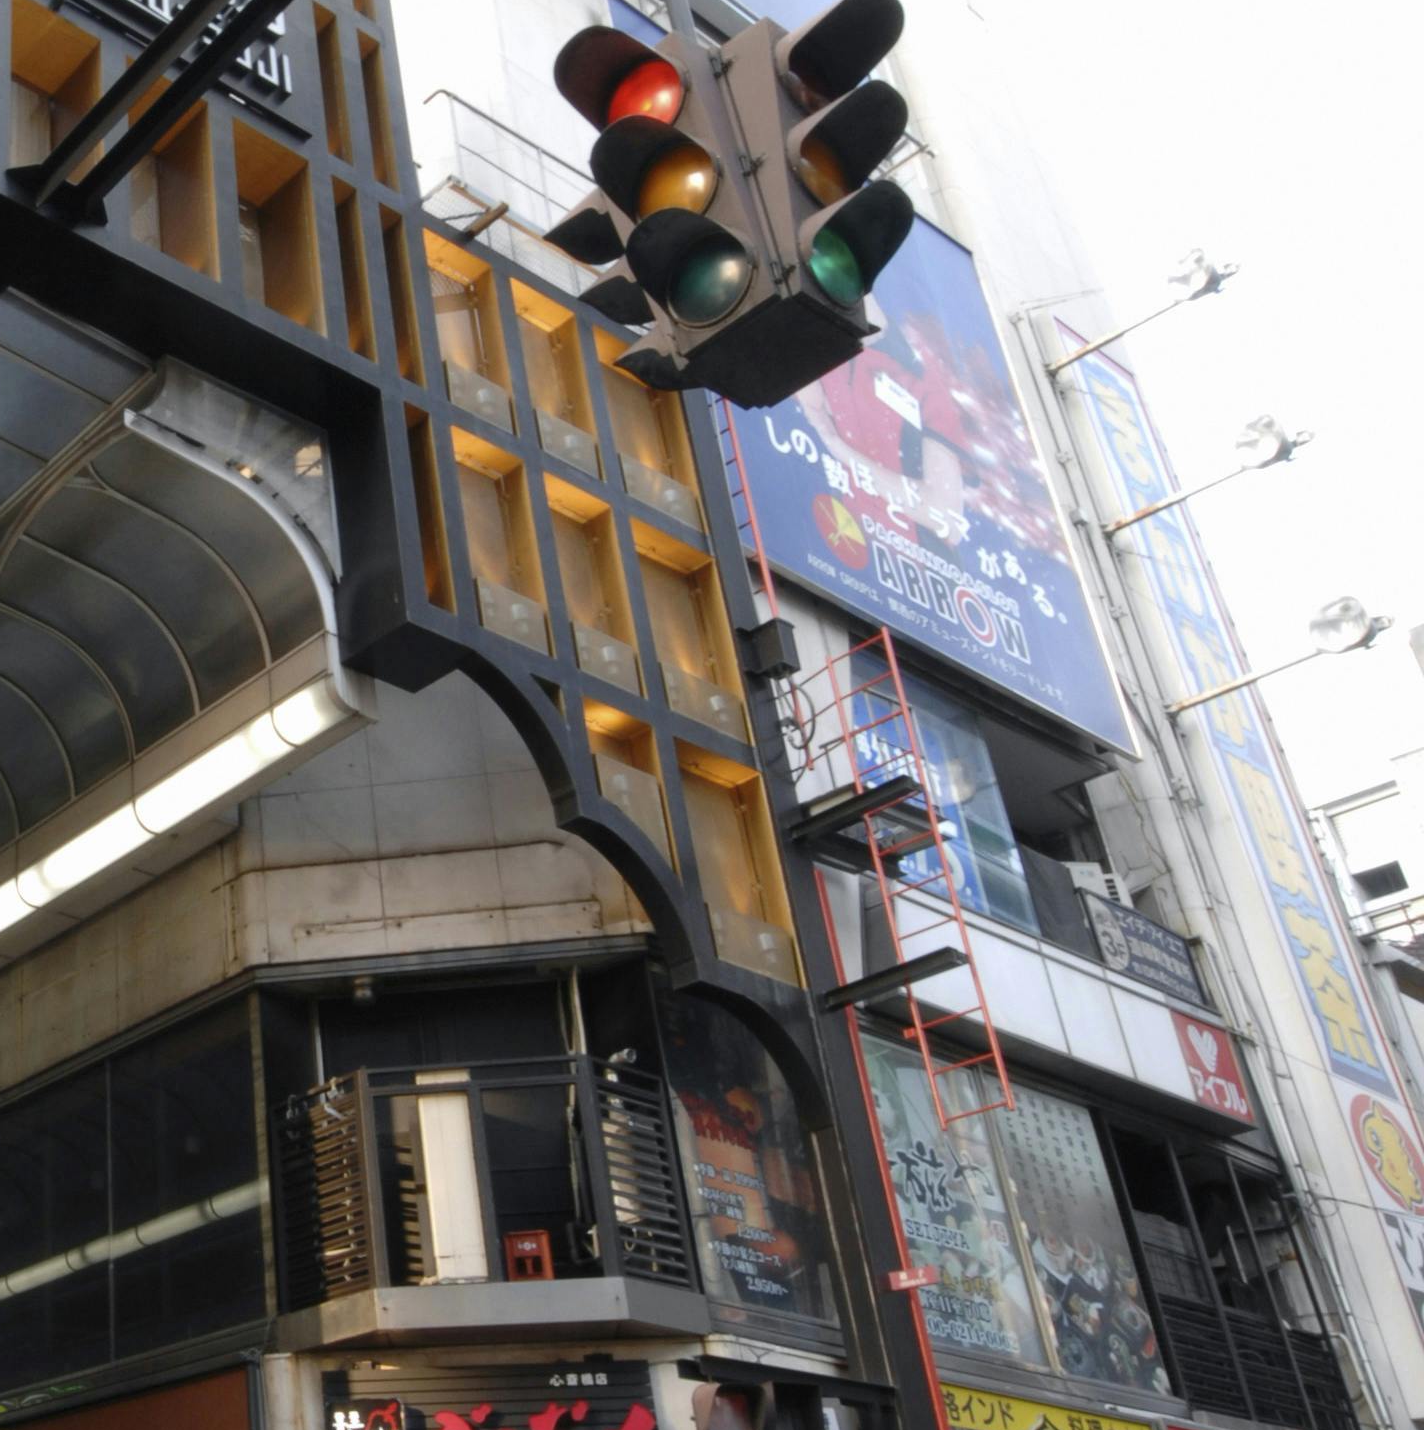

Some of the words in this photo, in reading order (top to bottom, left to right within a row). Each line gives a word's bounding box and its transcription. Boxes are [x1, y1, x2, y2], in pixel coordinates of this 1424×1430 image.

[872, 540, 1032, 667] ARROW
[1188, 1065, 1249, 1117] アイフル
